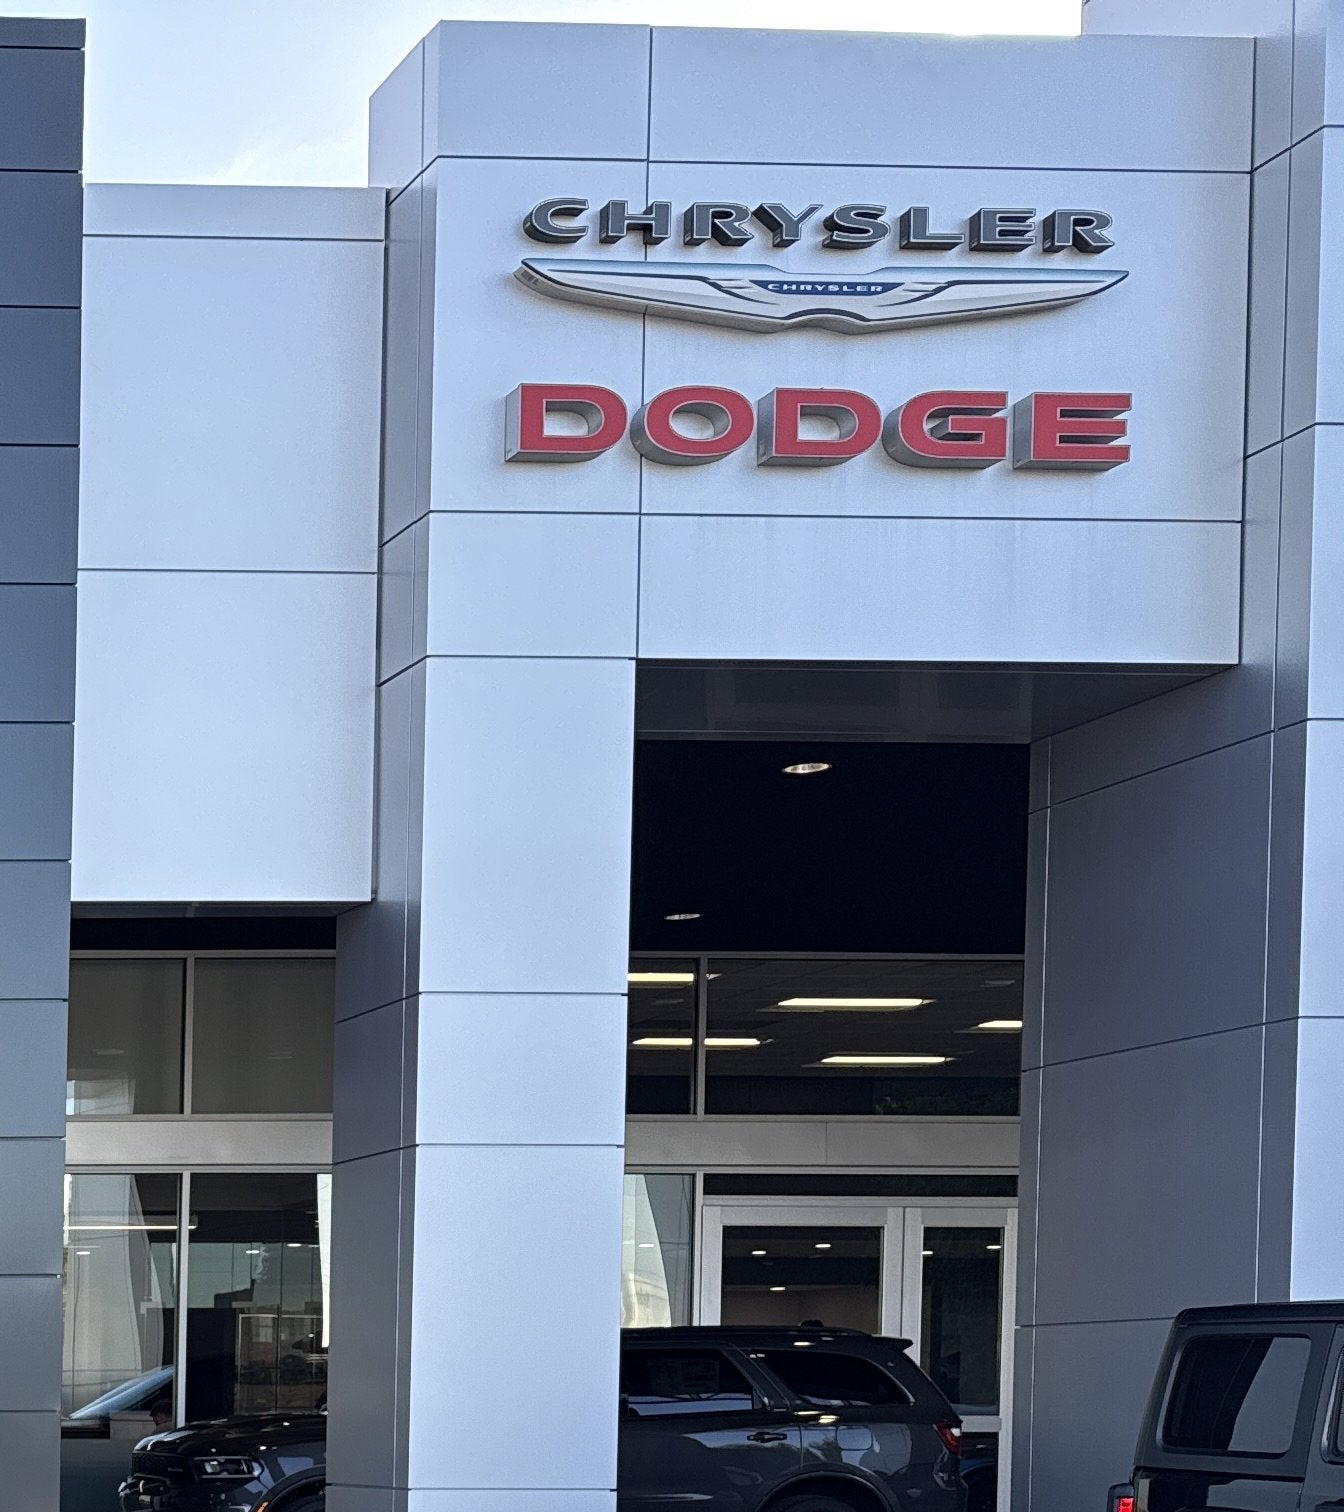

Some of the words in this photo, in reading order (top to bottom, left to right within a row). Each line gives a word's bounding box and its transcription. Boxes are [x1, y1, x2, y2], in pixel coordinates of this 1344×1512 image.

[522, 197, 1115, 254] CHRYSLER
[768, 283, 883, 292] CHRYSLER
[505, 383, 1133, 470] DODGE
